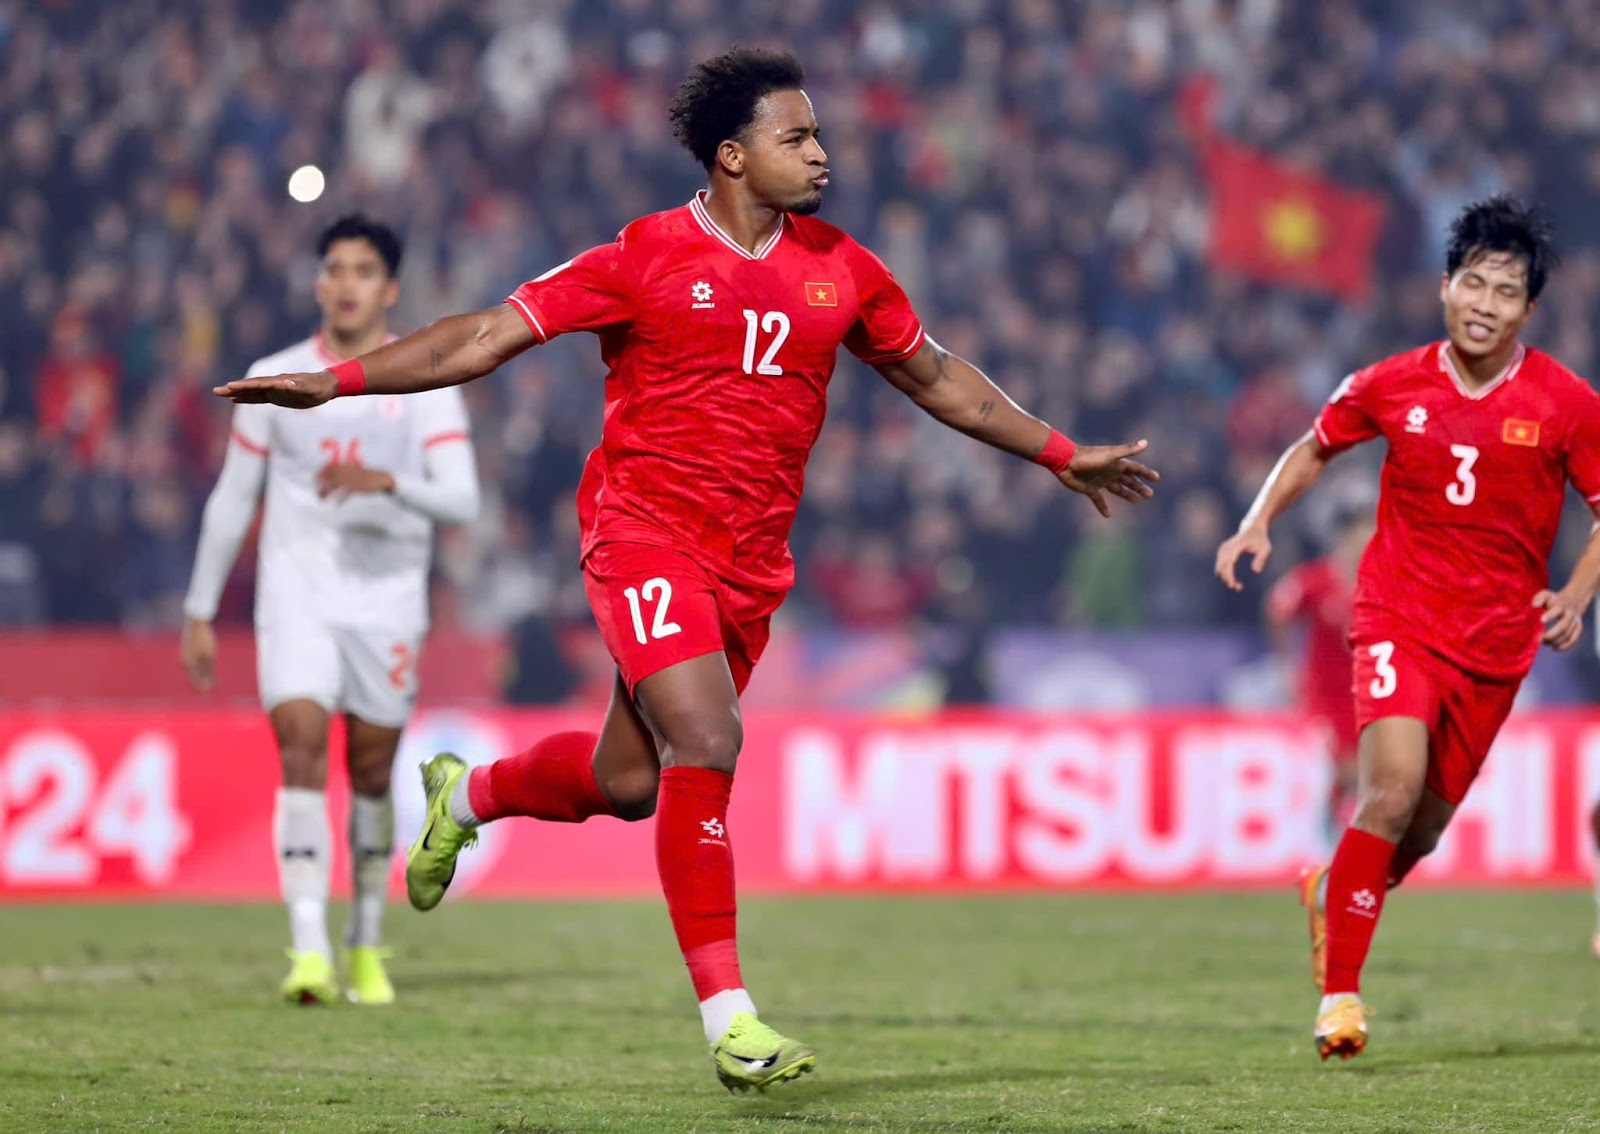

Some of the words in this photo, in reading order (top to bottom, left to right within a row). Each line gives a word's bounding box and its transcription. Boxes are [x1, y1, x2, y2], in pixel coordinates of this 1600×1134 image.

[742, 309, 791, 376] 12
[1446, 444, 1479, 506] 3
[623, 577, 682, 645] 12
[1368, 641, 1397, 699] 3
[2, 731, 192, 884] 24
